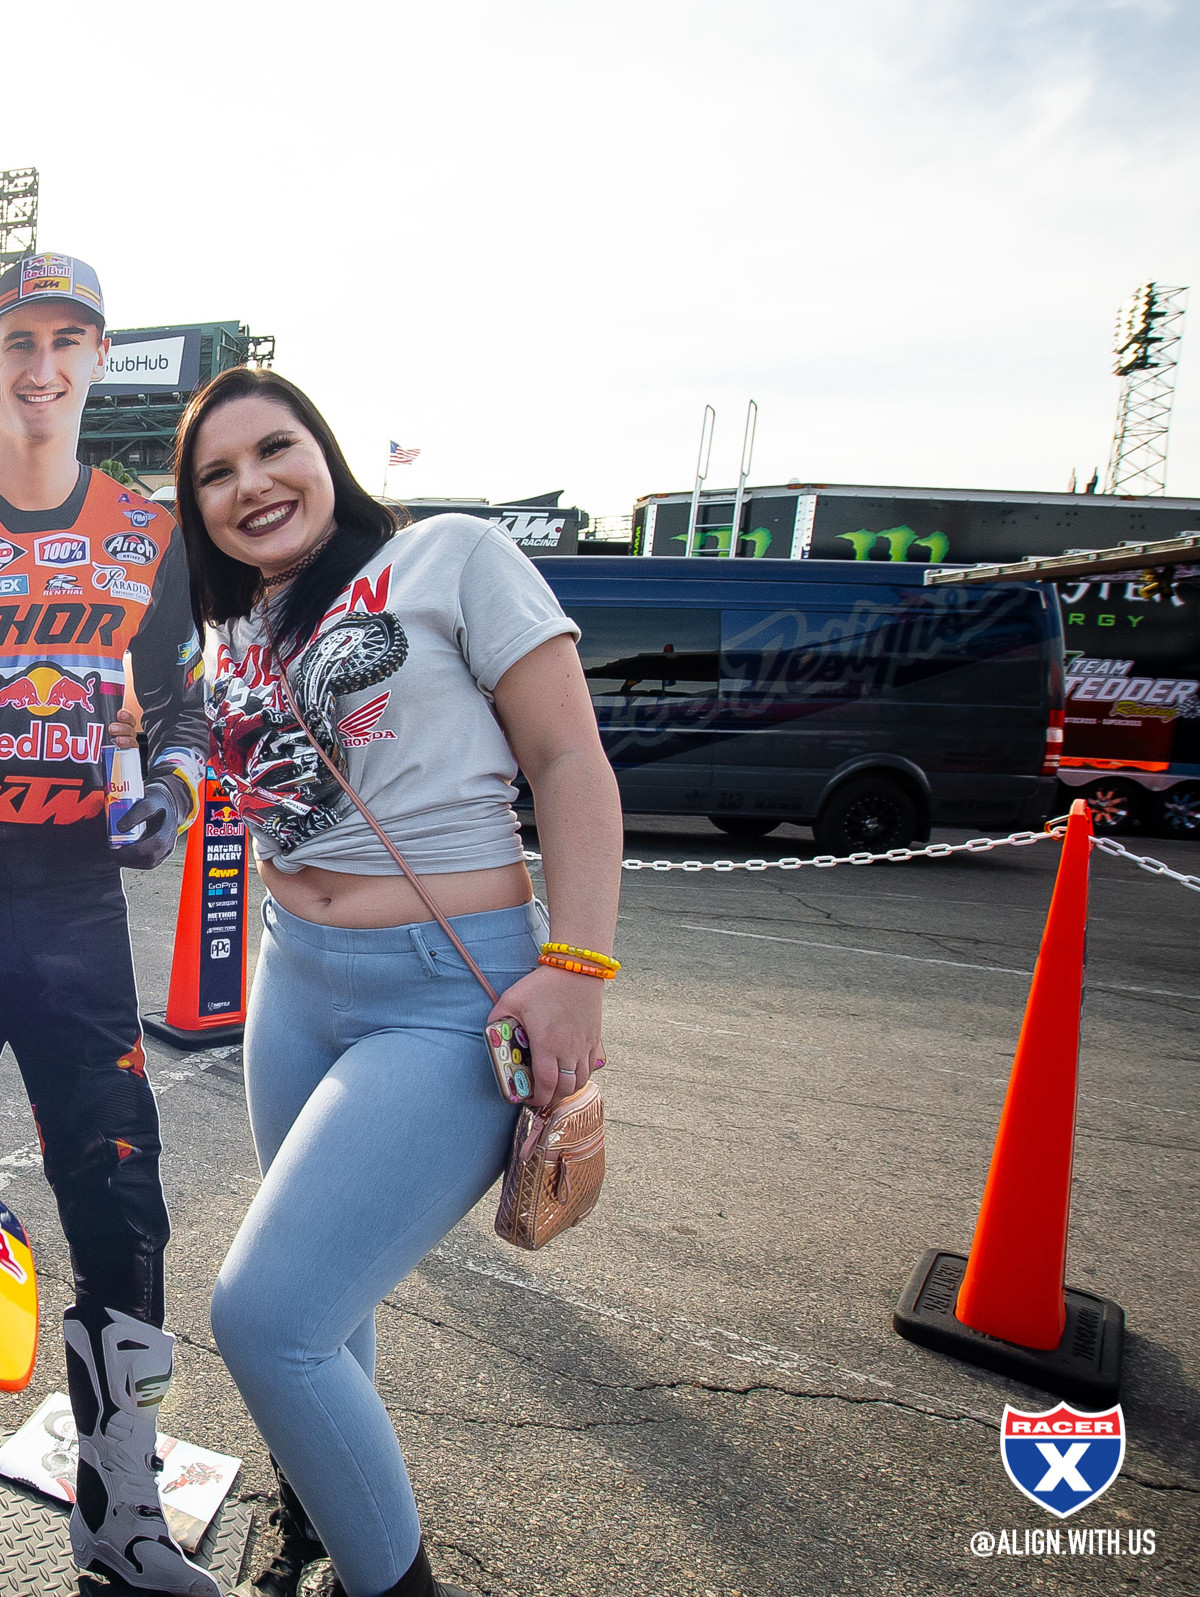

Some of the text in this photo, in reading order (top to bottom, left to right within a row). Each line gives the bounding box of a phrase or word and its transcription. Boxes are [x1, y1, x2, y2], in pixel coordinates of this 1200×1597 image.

[24, 266, 71, 280] Red Bull
[488, 511, 566, 540] KTM
[42, 541, 83, 560] 100%
[107, 536, 154, 559] Airoh
[521, 538, 559, 547] RACING
[42, 588, 84, 596] RENTHAL
[1067, 612, 1145, 628] RGY
[1071, 659, 1135, 676] TEAM
[1065, 676, 1200, 704] TEDDER
[1111, 700, 1178, 723] Racing
[42, 722, 104, 763] Bull
[343, 730, 397, 748] HONDA
[111, 781, 130, 793] Bull
[206, 823, 244, 837] Red Bull
[207, 853, 242, 861] BAKERY
[207, 911, 237, 919] METHOD
[212, 941, 230, 957] PPG
